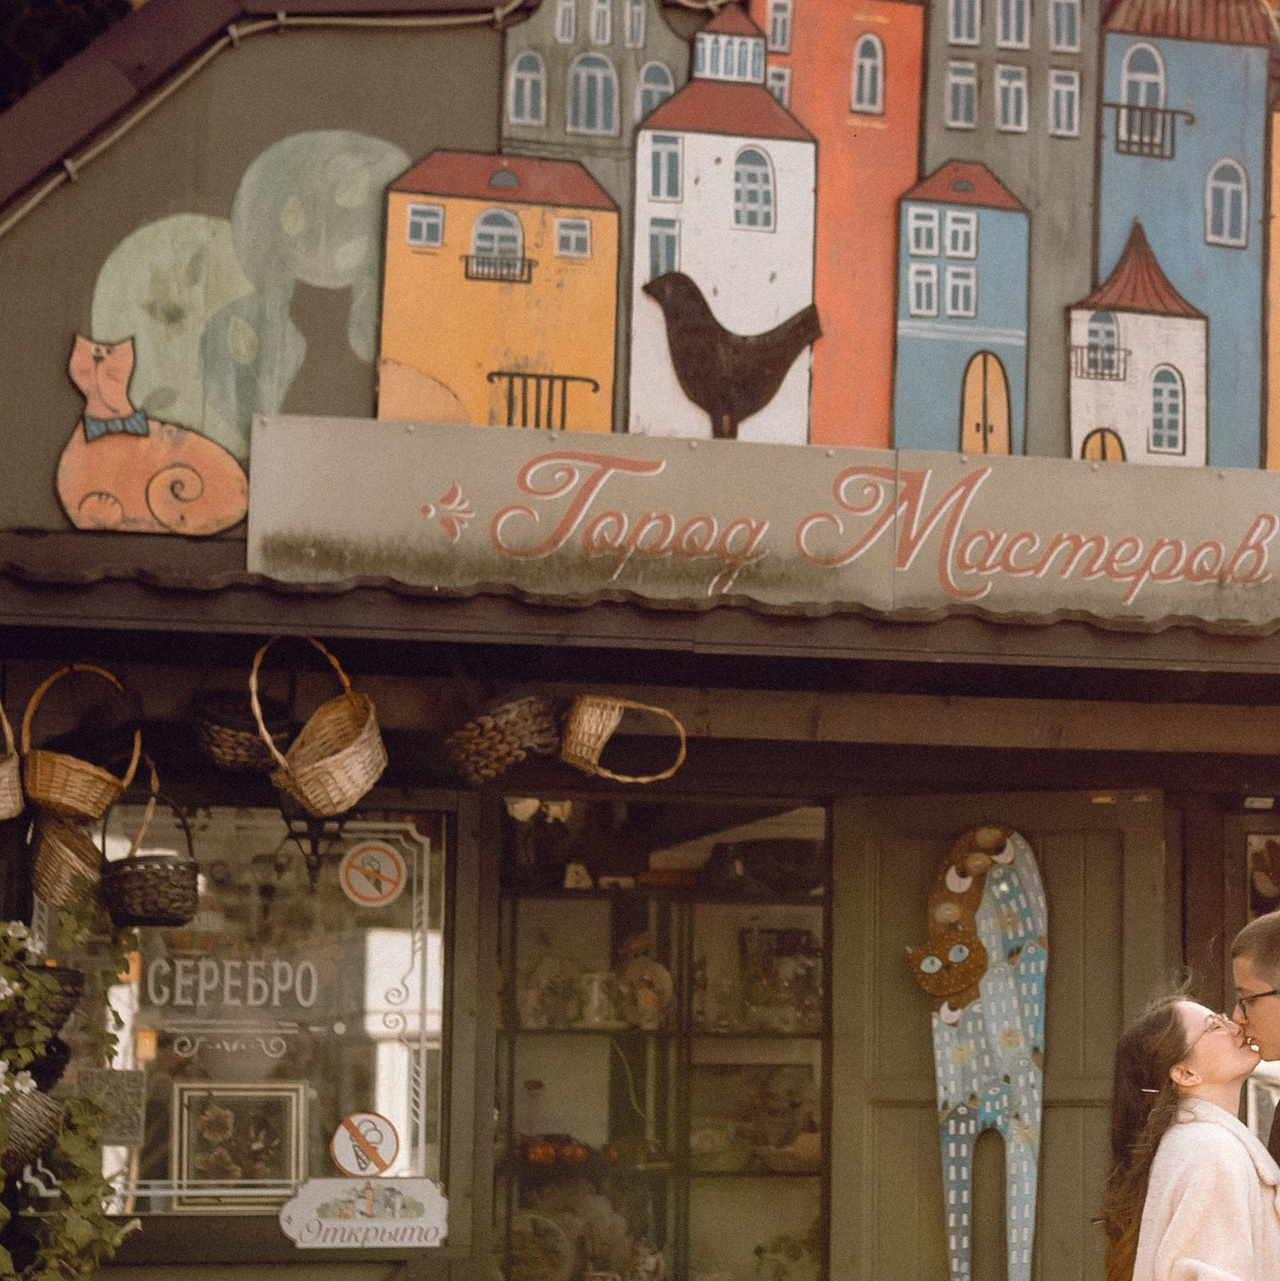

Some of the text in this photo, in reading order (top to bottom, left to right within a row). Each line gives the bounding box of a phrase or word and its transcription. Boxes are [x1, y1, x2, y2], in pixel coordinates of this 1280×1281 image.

[489, 450, 1280, 605] Город Мастеров
[146, 958, 319, 1008] СЕРЕБРО
[297, 1219, 440, 1248] Открыто
